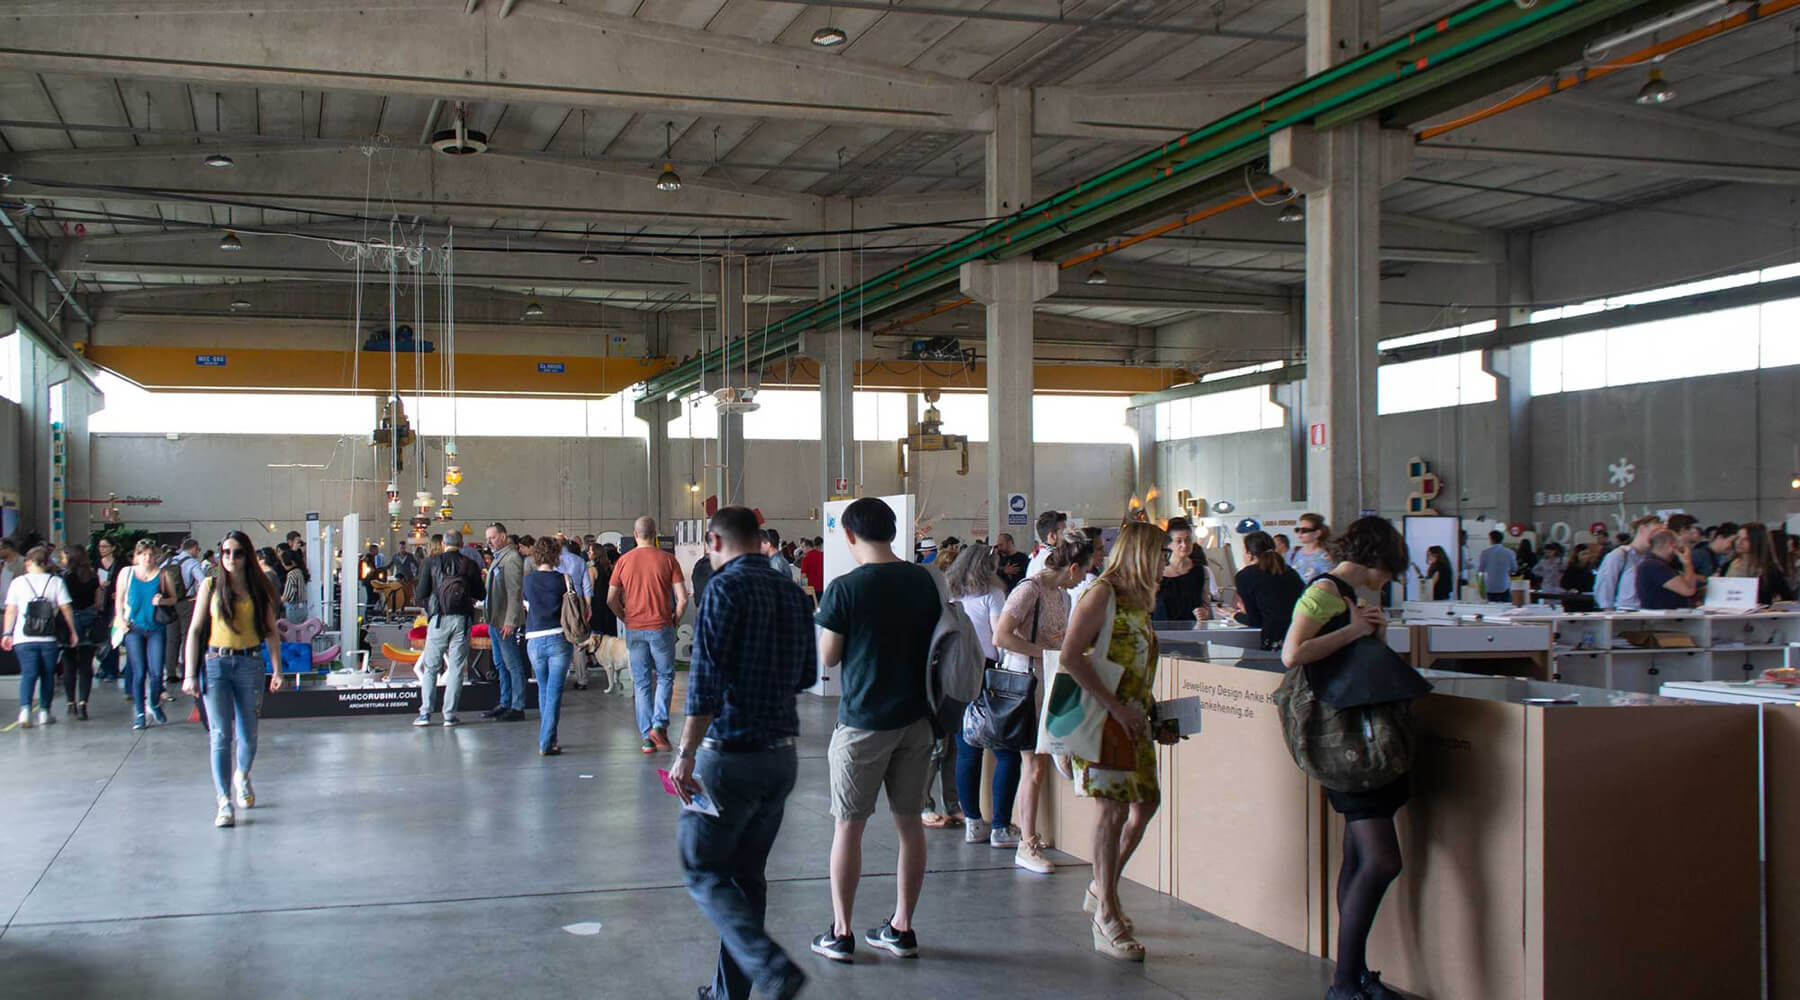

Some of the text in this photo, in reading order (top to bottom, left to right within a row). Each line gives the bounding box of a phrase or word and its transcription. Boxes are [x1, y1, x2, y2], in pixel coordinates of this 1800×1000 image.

[1563, 491, 1624, 504] DIFFERENT
[339, 691, 418, 701] MARCORUBINI.COM
[1182, 680, 1216, 696] Jewellery
[1217, 685, 1243, 701] Design
[1245, 690, 1264, 703] Anke
